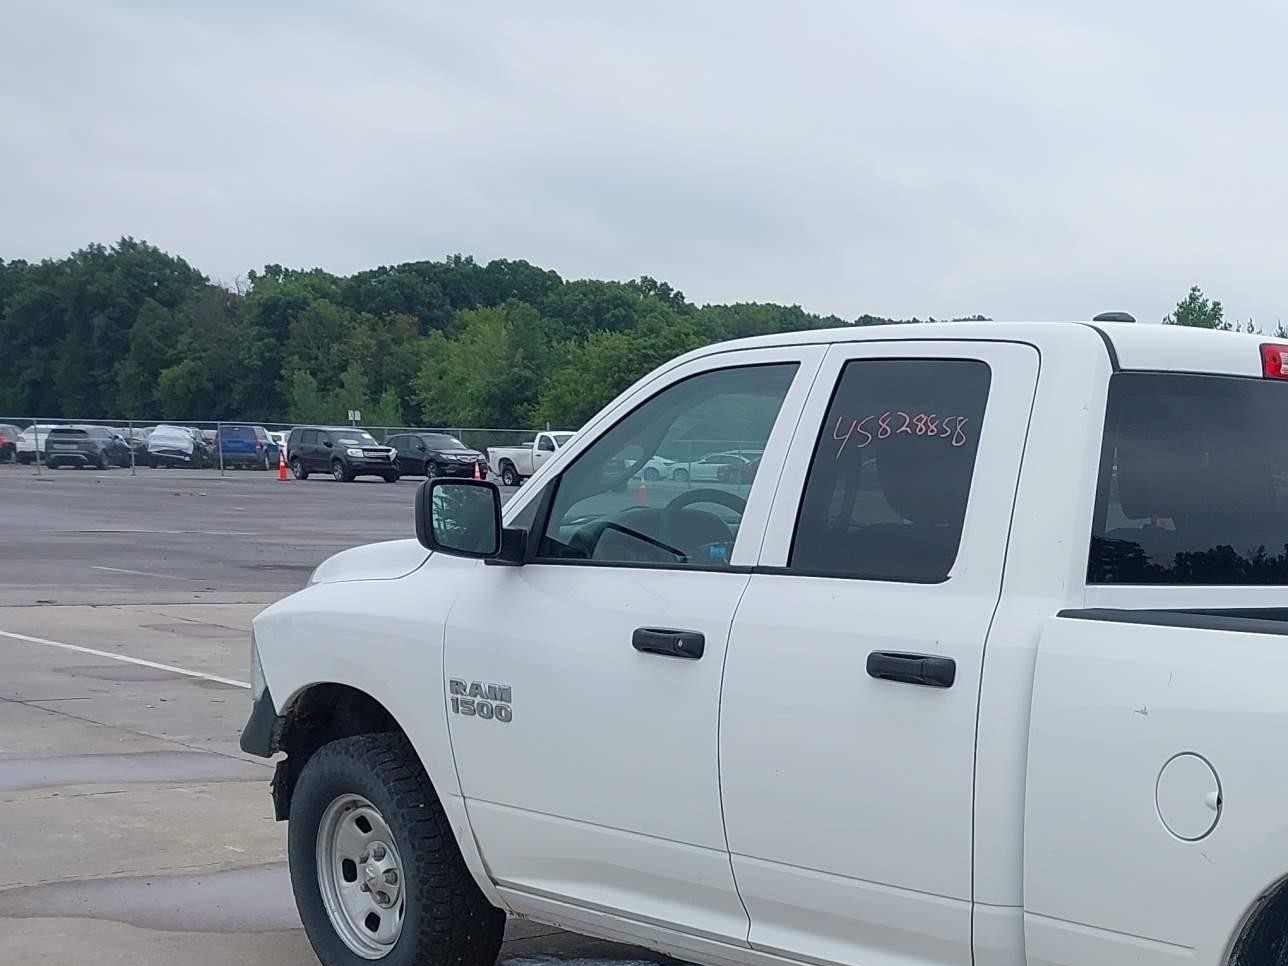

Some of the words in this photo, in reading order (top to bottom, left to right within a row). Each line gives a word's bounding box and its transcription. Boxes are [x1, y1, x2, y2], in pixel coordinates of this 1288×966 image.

[832, 411, 969, 460] 45828858
[449, 678, 512, 704] RAM
[450, 696, 513, 723] 1500
